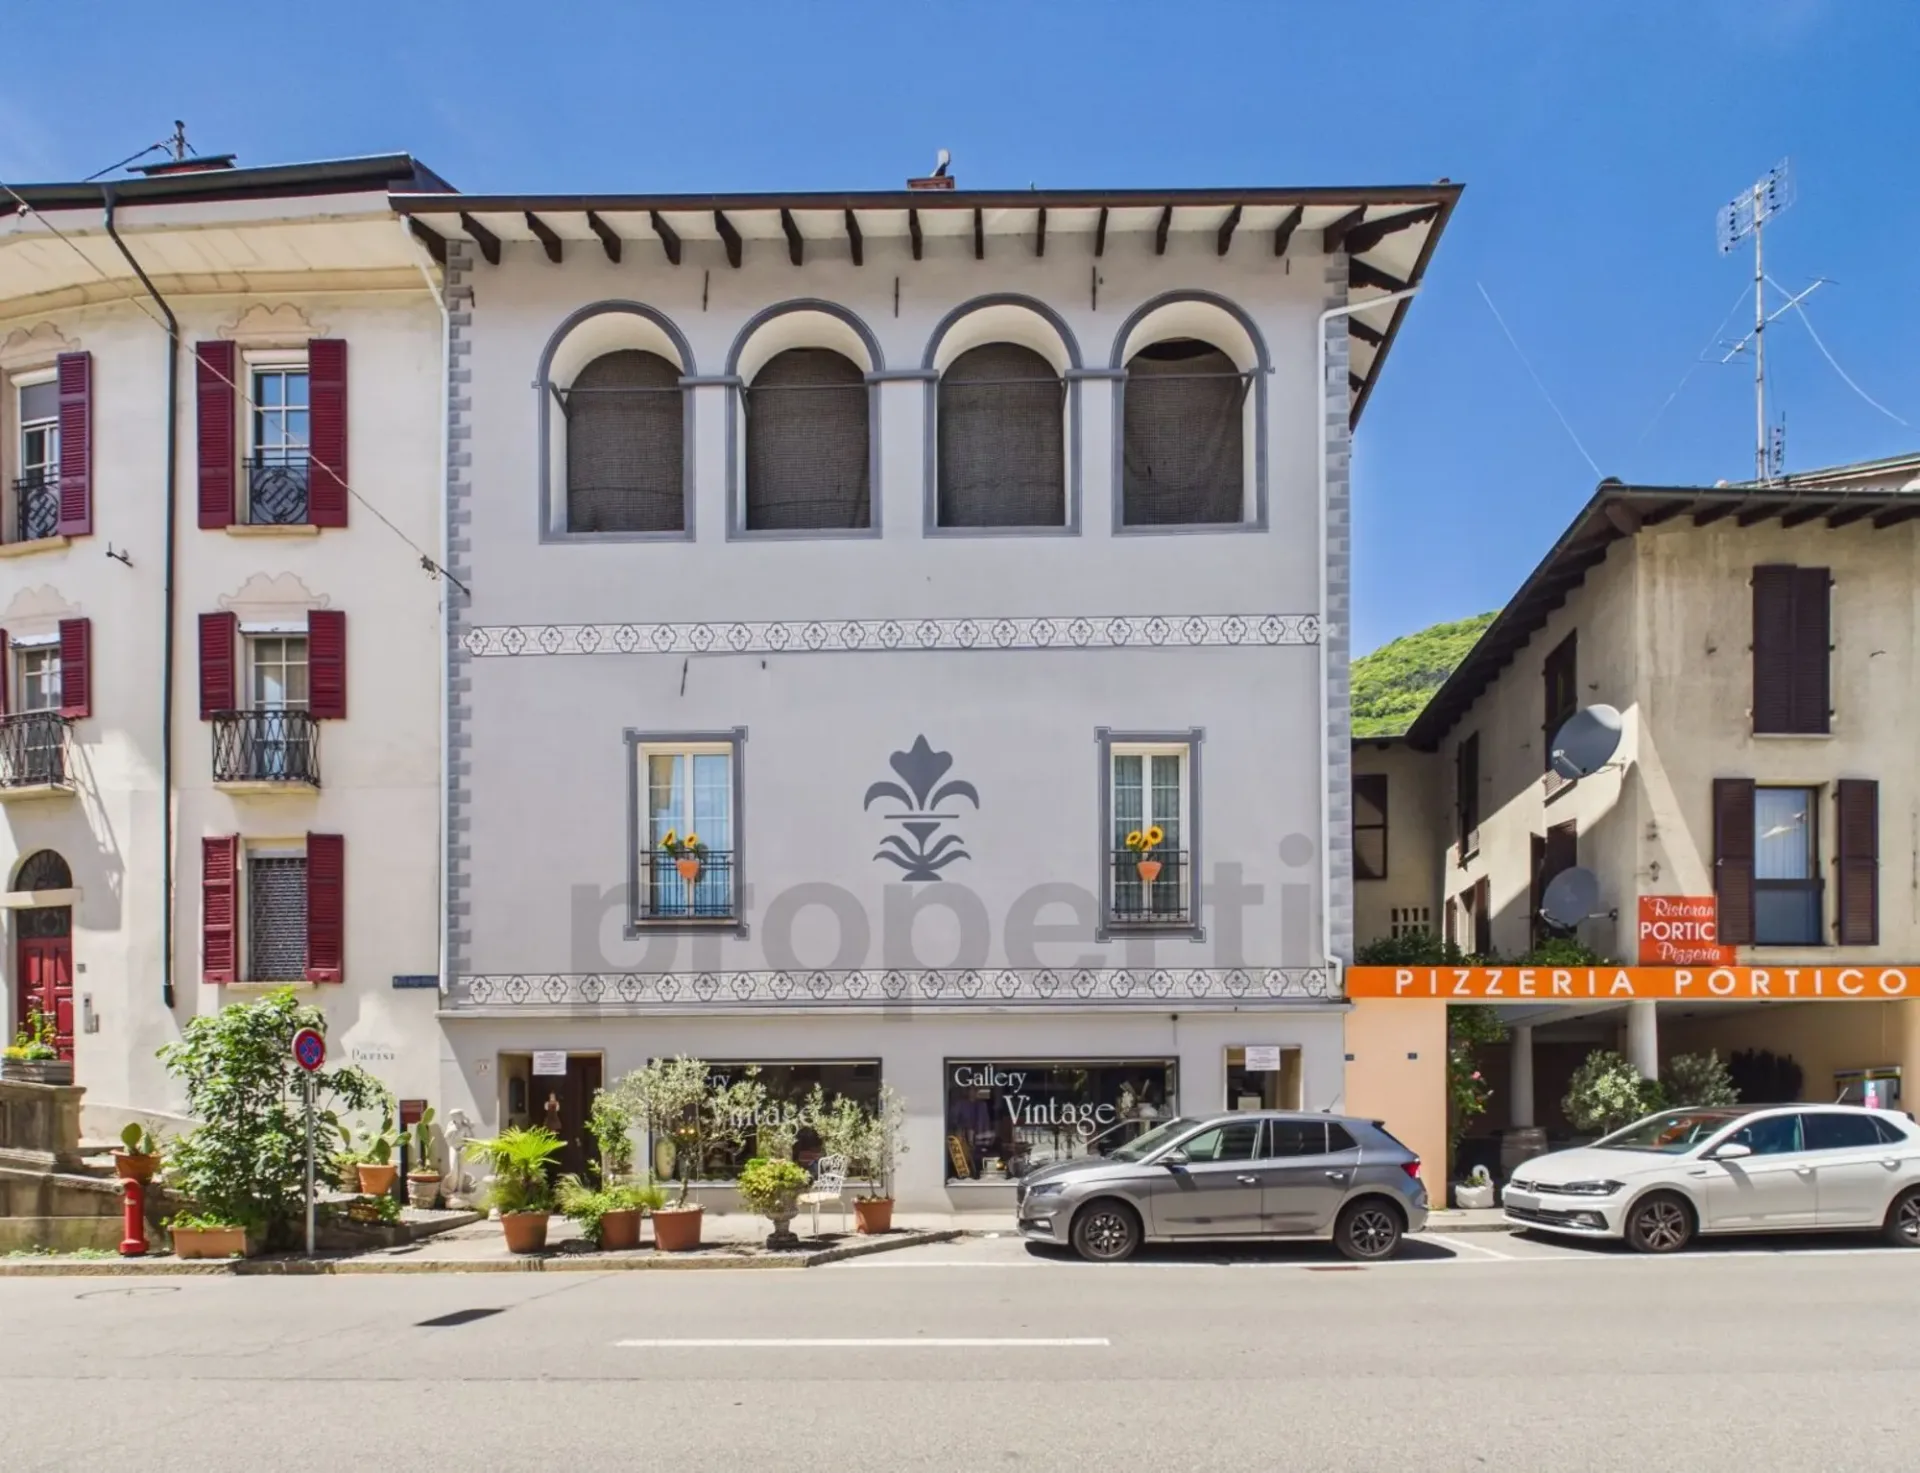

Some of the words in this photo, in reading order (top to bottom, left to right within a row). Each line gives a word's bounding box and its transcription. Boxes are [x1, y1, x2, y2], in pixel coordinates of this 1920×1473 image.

[1645, 898, 1714, 917] Ristoran
[1640, 921, 1715, 941] PORTIC
[1656, 941, 1720, 965] Pizzeria
[1395, 969, 1634, 995] PIZZERIA
[1675, 968, 1907, 995] PORTICO
[954, 1063, 1027, 1093] Gallery
[1003, 1094, 1116, 1136] Vintage
